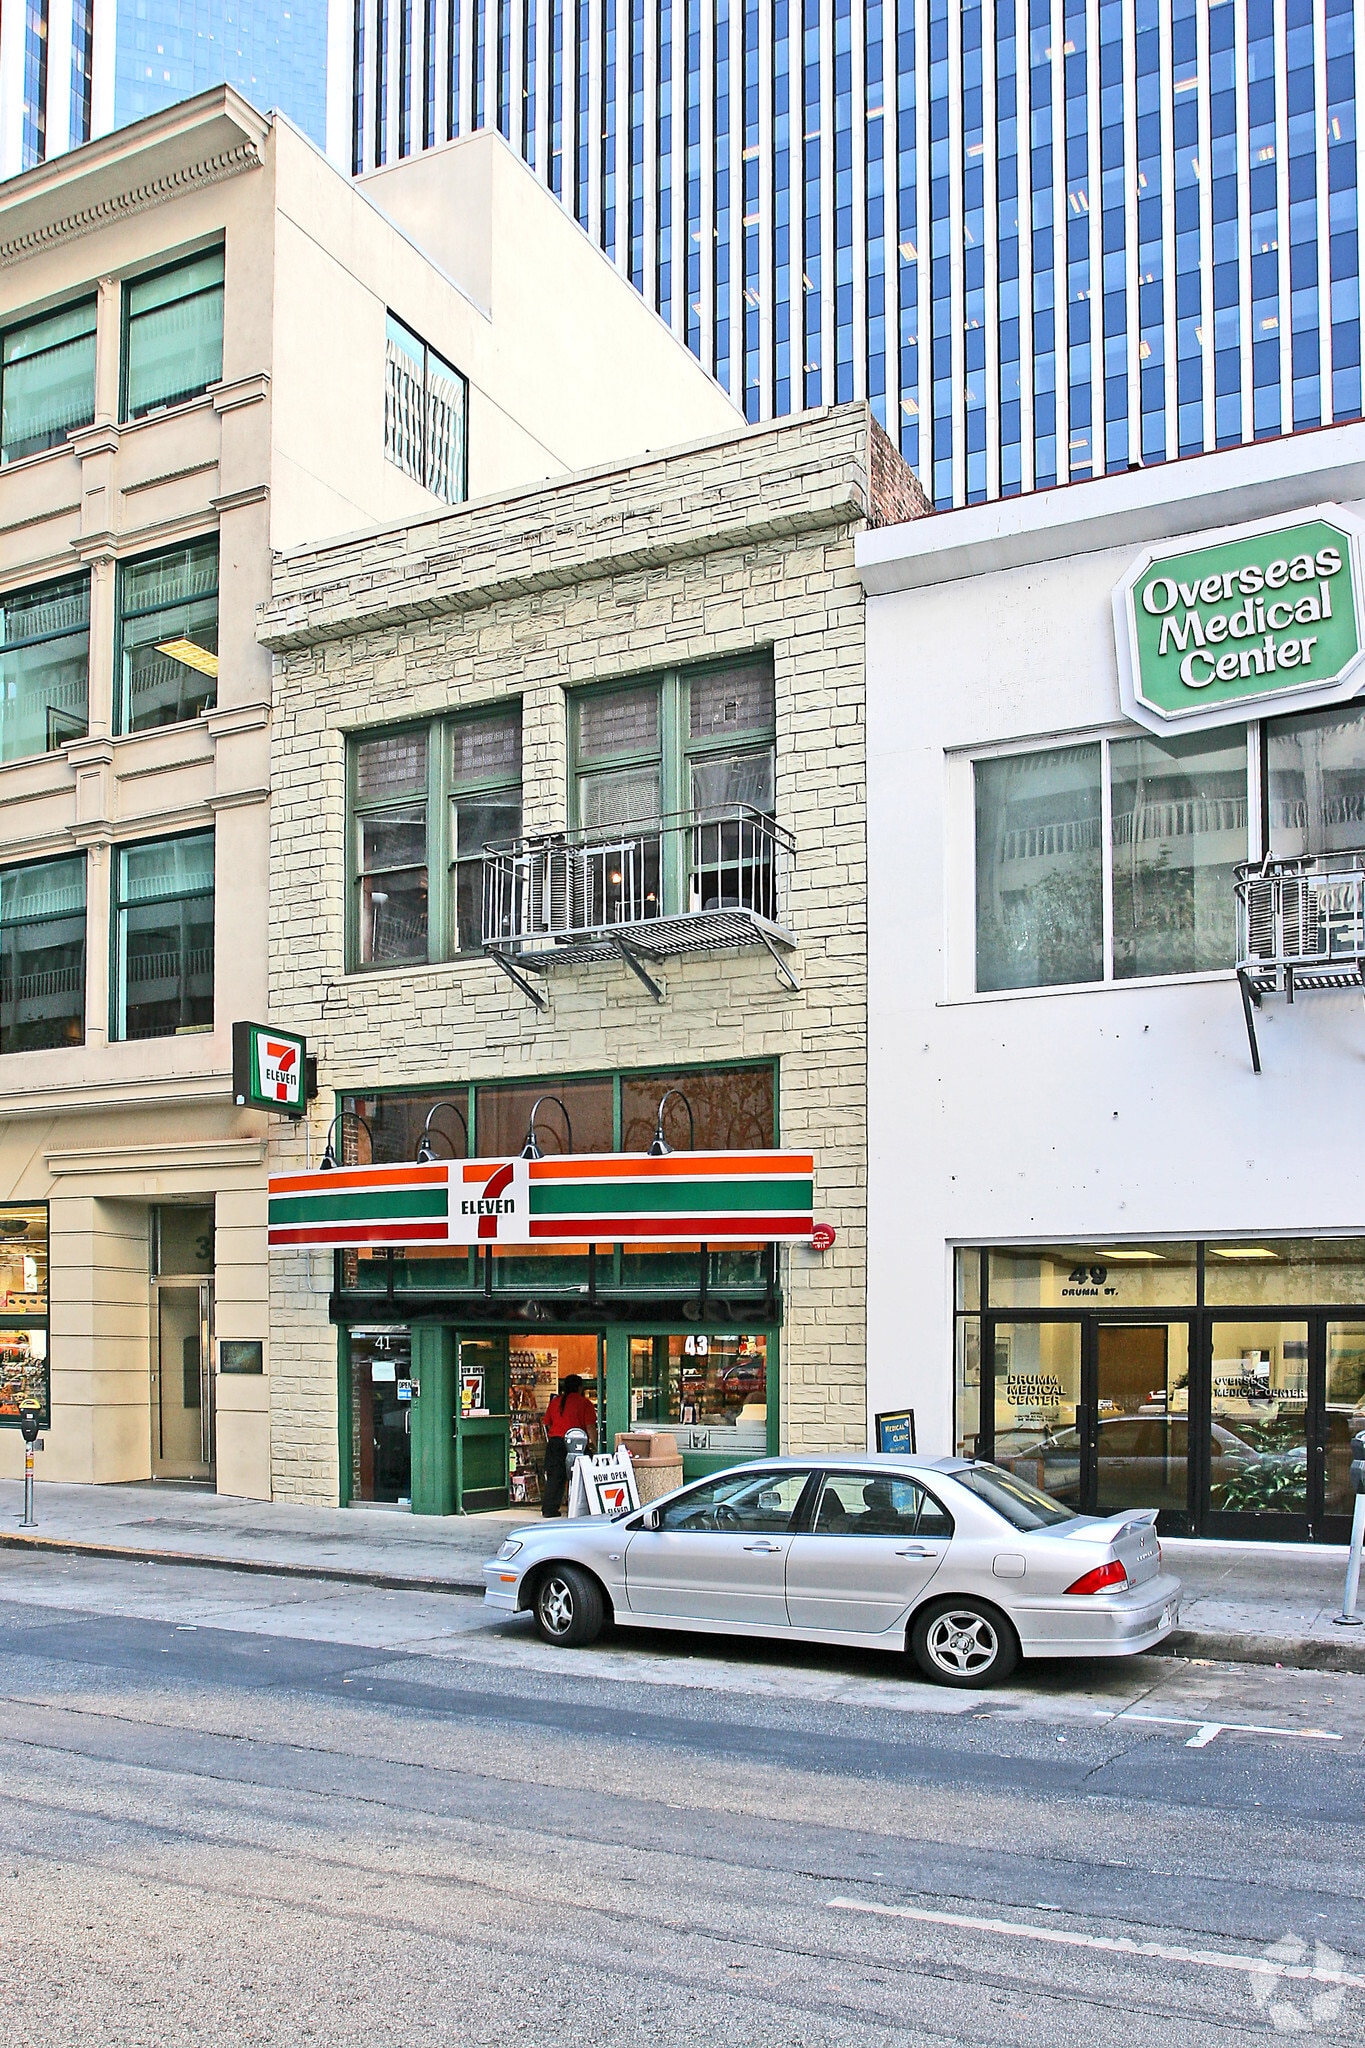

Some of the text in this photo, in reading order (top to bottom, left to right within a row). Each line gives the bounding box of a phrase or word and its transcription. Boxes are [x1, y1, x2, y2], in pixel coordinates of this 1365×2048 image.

[1142, 547, 1342, 615] Overseas
[1157, 580, 1333, 656] Medical
[1179, 634, 1318, 688] Center
[267, 1042, 296, 1100] 7
[462, 1163, 514, 1238] 7
[1068, 1264, 1107, 1285] 49
[1061, 1287, 1119, 1296] DRUMM ST.
[374, 1335, 392, 1350] 41
[685, 1335, 708, 1356] 43
[1007, 1374, 1059, 1385] DRUMM
[1214, 1377, 1270, 1387] OVERSEAS
[1006, 1385, 1067, 1395] MEDICAL
[1214, 1388, 1306, 1399] MEDICAL CENTER
[1007, 1395, 1060, 1406] CENTER
[593, 1471, 628, 1482] NOW OPEN
